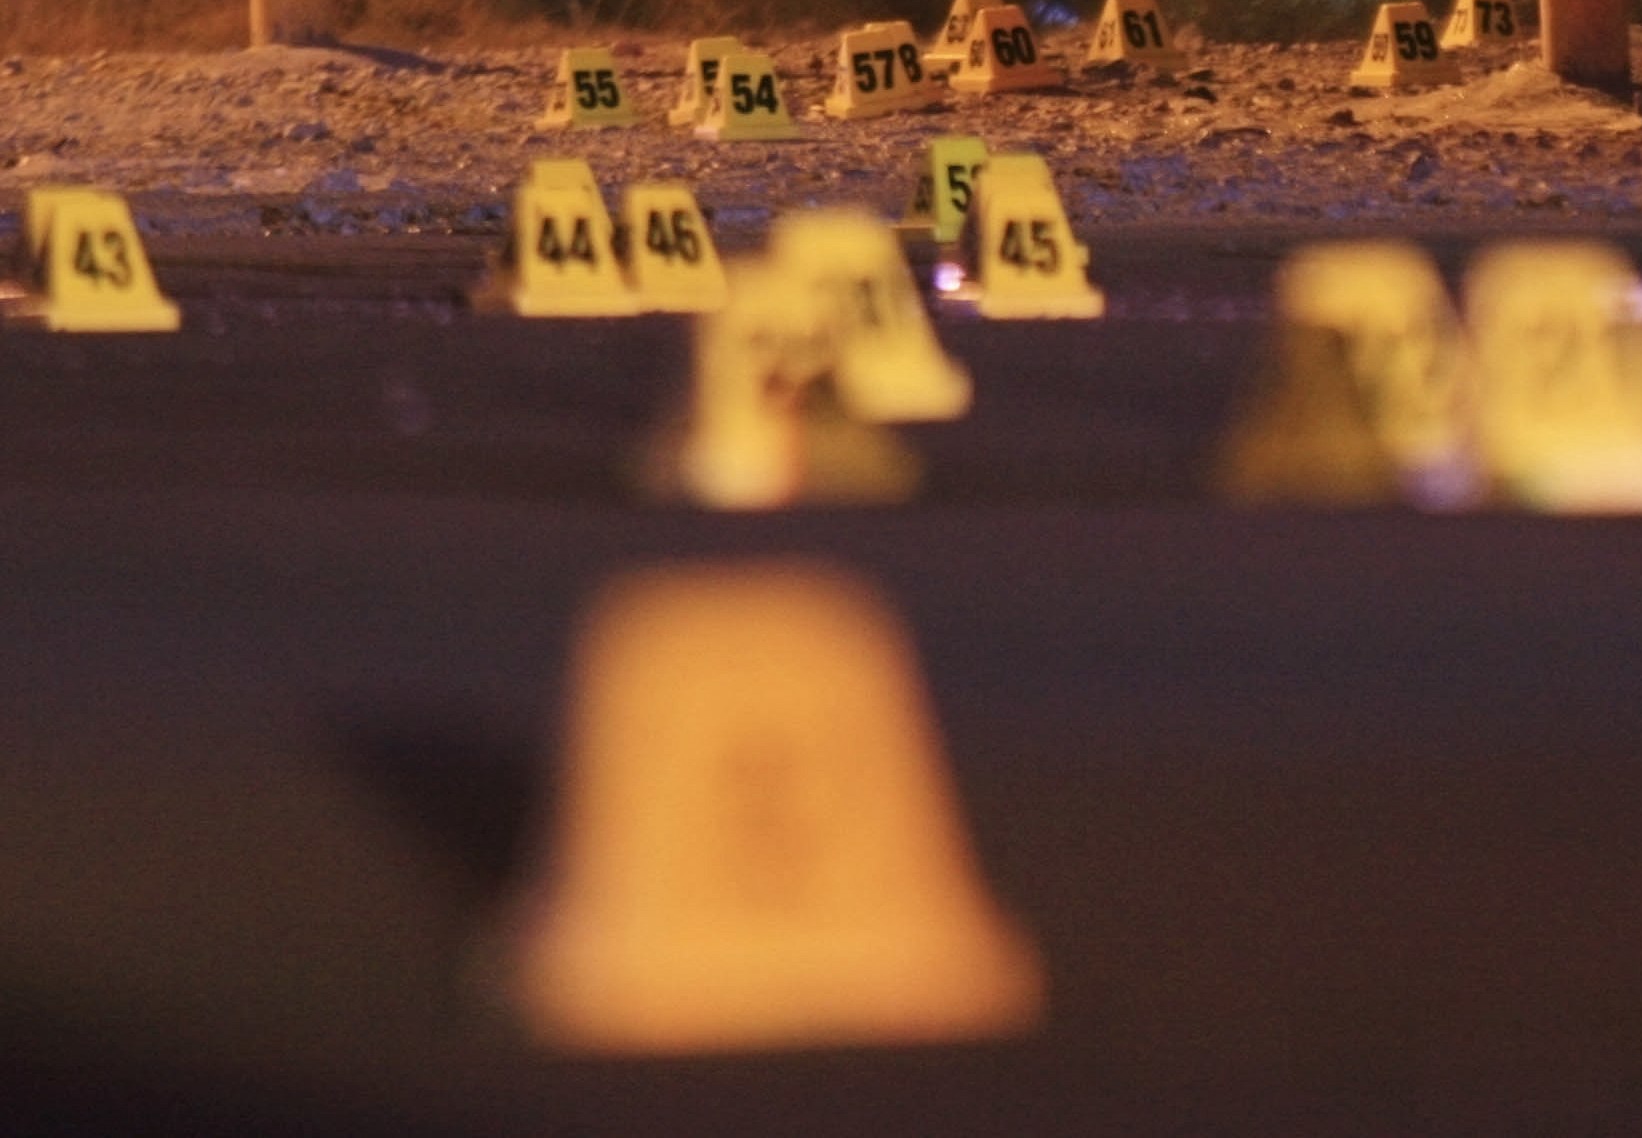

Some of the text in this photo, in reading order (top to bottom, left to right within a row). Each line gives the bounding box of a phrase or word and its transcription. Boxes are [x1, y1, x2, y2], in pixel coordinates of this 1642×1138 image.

[1123, 10, 1163, 48] 61
[1476, 0, 1514, 36] 73
[992, 26, 1036, 67] 60
[1395, 20, 1438, 60] 59
[573, 70, 620, 109] 55
[852, 49, 895, 92] 57
[731, 74, 778, 113] 54
[537, 215, 598, 270] 44
[645, 209, 701, 264] 46
[1001, 218, 1061, 276] 45
[73, 230, 132, 288] 43
